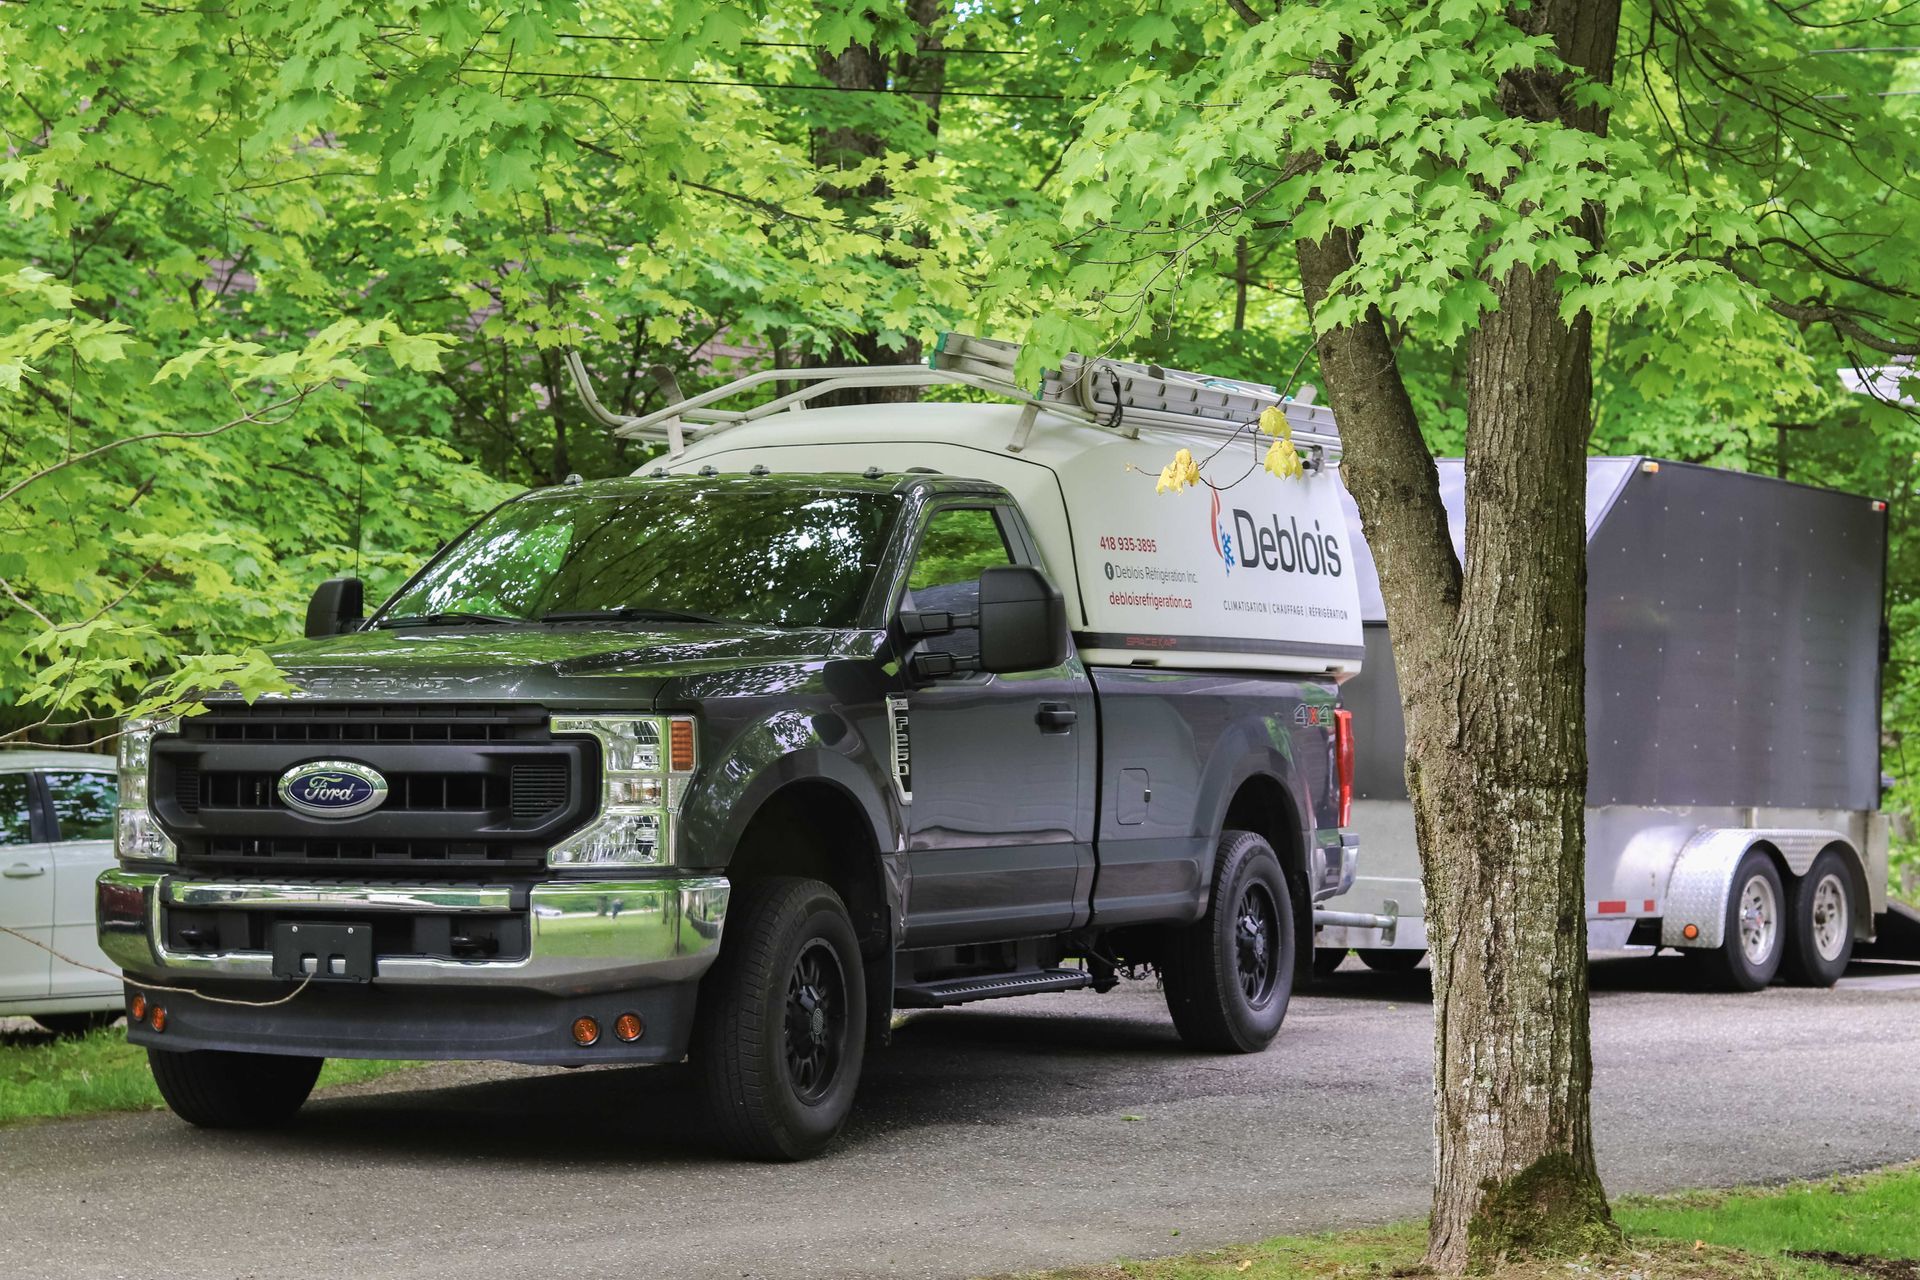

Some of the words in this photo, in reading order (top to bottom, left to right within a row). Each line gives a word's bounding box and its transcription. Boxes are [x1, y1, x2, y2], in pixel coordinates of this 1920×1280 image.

[1100, 536, 1116, 551] 418
[1118, 537, 1157, 553] 935-3895
[1233, 509, 1341, 577] Deblois
[1115, 565, 1144, 580] Deblois
[1109, 592, 1192, 611] debloisrefrigeration.ca
[1223, 600, 1268, 613] CLIMATISATION
[1272, 603, 1304, 615] CHAUFFAGE
[304, 776, 355, 801] Ford
